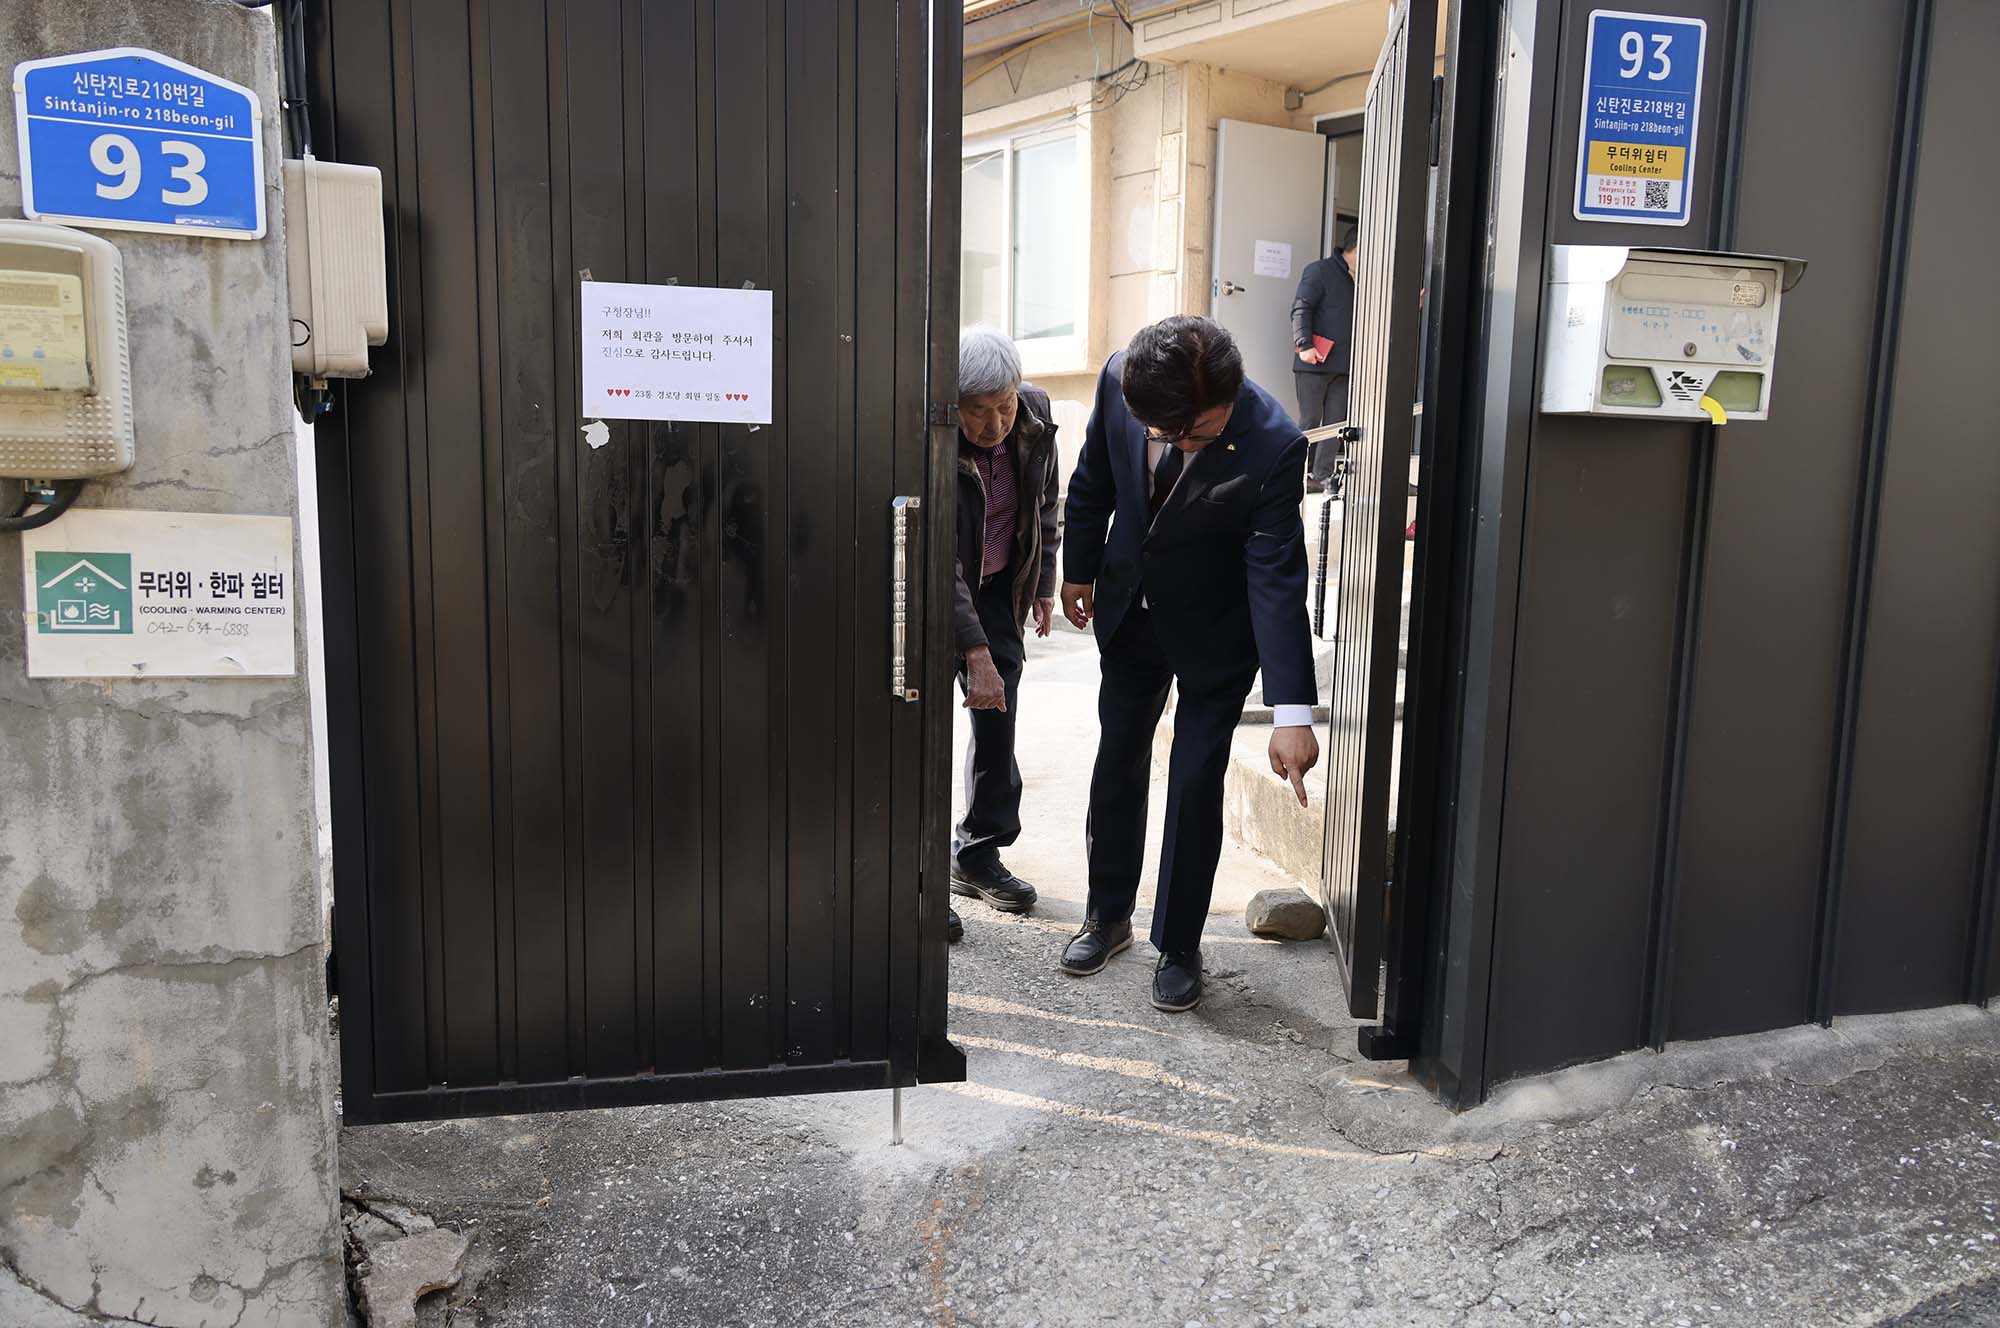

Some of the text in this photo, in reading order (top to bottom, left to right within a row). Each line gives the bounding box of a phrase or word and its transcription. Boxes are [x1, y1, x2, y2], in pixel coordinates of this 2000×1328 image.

[1619, 31, 1673, 81] 93
[73, 71, 205, 107] 신탄진로218번길
[45, 96, 234, 129] Sintanjin-ro 218beon-gil
[1596, 96, 1686, 120] 신탄진로218번길
[1594, 118, 1685, 136] Sintanjin-ro 218beon-gil
[1606, 146, 1668, 163] 무더위쉼터
[90, 133, 209, 207] 93
[1610, 163, 1662, 175] Cooling Center
[1598, 194, 1613, 205] 119
[1622, 196, 1636, 207] 112
[602, 329, 623, 340] 저희
[632, 330, 664, 343] 회관을
[672, 332, 713, 344] 방문하여
[602, 347, 717, 362] 진심으로 감사드립니다.
[139, 571, 192, 599] 무더위
[210, 572, 244, 599] 한파
[251, 572, 285, 600] 쉼터
[139, 606, 187, 615] (COOLING
[196, 607, 241, 615] WARMING
[244, 606, 286, 615] CENTER)
